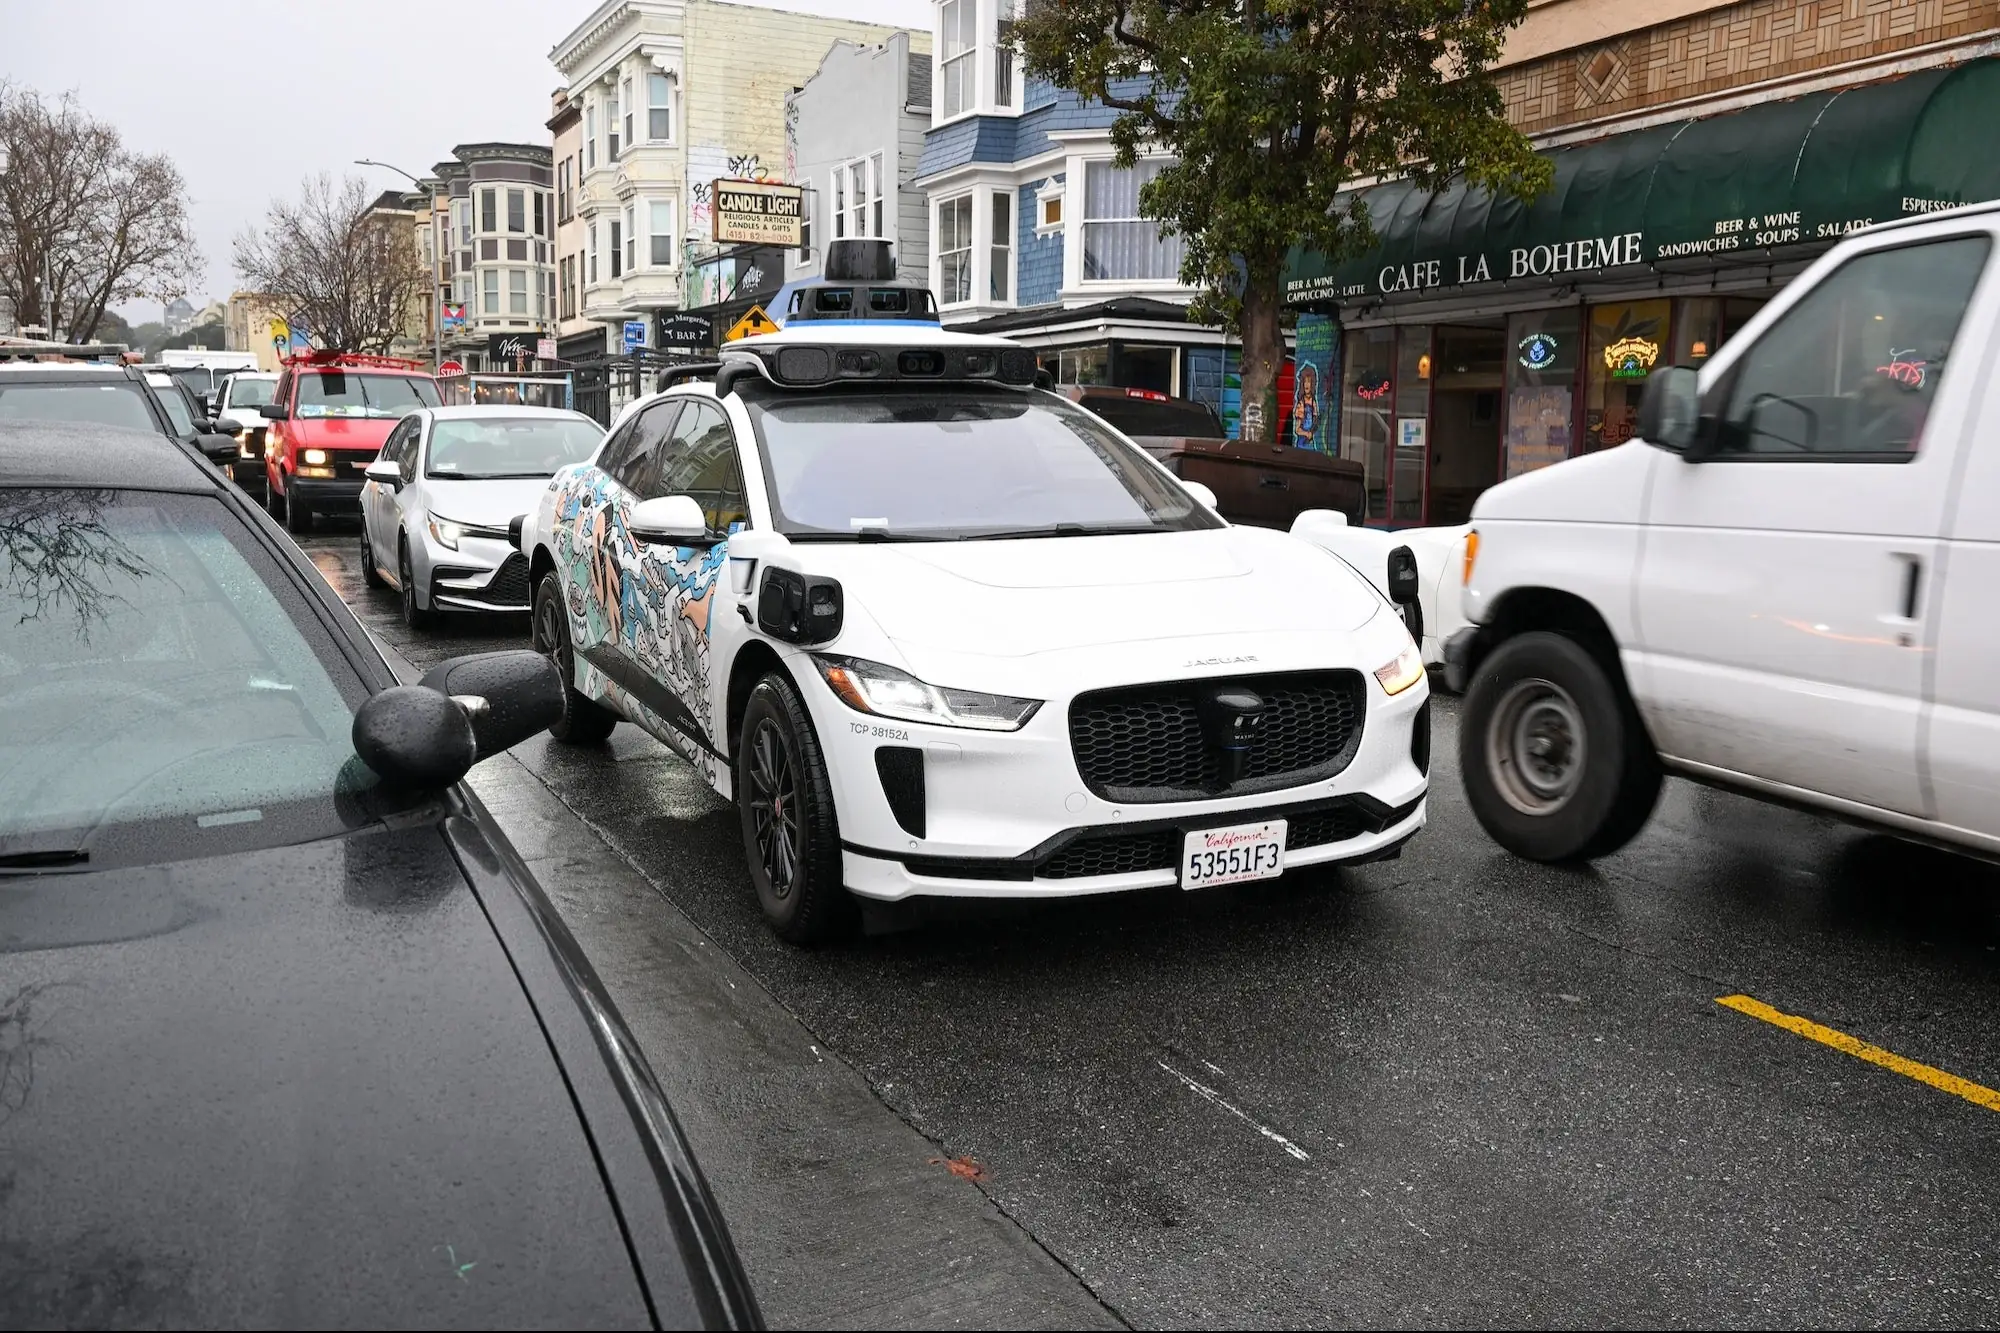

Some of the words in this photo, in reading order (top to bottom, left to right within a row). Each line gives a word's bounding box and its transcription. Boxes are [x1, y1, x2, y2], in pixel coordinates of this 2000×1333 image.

[719, 193, 763, 213] CANDLE
[767, 194, 800, 215] LIGHT
[724, 212, 760, 222] RELIGIOUS
[764, 216, 794, 225] ARTICLES
[728, 221, 759, 230] CANDLES
[1715, 219, 1743, 235] BEER
[1748, 217, 1758, 230] &
[1764, 211, 1801, 228] WINE
[726, 230, 746, 239] (415)
[1657, 236, 1739, 258] SANDWICHES
[1755, 228, 1800, 246] SOUPS
[1816, 218, 1873, 238] SALADS
[1378, 260, 1441, 294] CAFE
[1458, 253, 1492, 284] LA
[1510, 232, 1643, 278] BOHEME
[1287, 280, 1304, 291] BEER
[1306, 278, 1312, 288] &
[1314, 276, 1334, 287] WINE
[1287, 287, 1335, 303] CAPPUCCINO
[1343, 284, 1366, 297] LATTE
[661, 317, 675, 326] Las
[675, 314, 711, 327] Margaritas
[676, 331, 697, 340] BAR
[1519, 333, 1539, 349] ANCHOR
[1540, 334, 1557, 347] STEAM
[1519, 356, 1529, 367] SAN
[1529, 354, 1556, 369] FRANCISCO
[440, 368, 463, 377] STOP
[1357, 380, 1390, 400] Coffee
[1182, 655, 1260, 668] JAGUAR
[849, 722, 869, 734] TCP
[871, 726, 909, 741] 38152A
[1206, 831, 1268, 849] California
[1190, 843, 1279, 880] 53551F3
